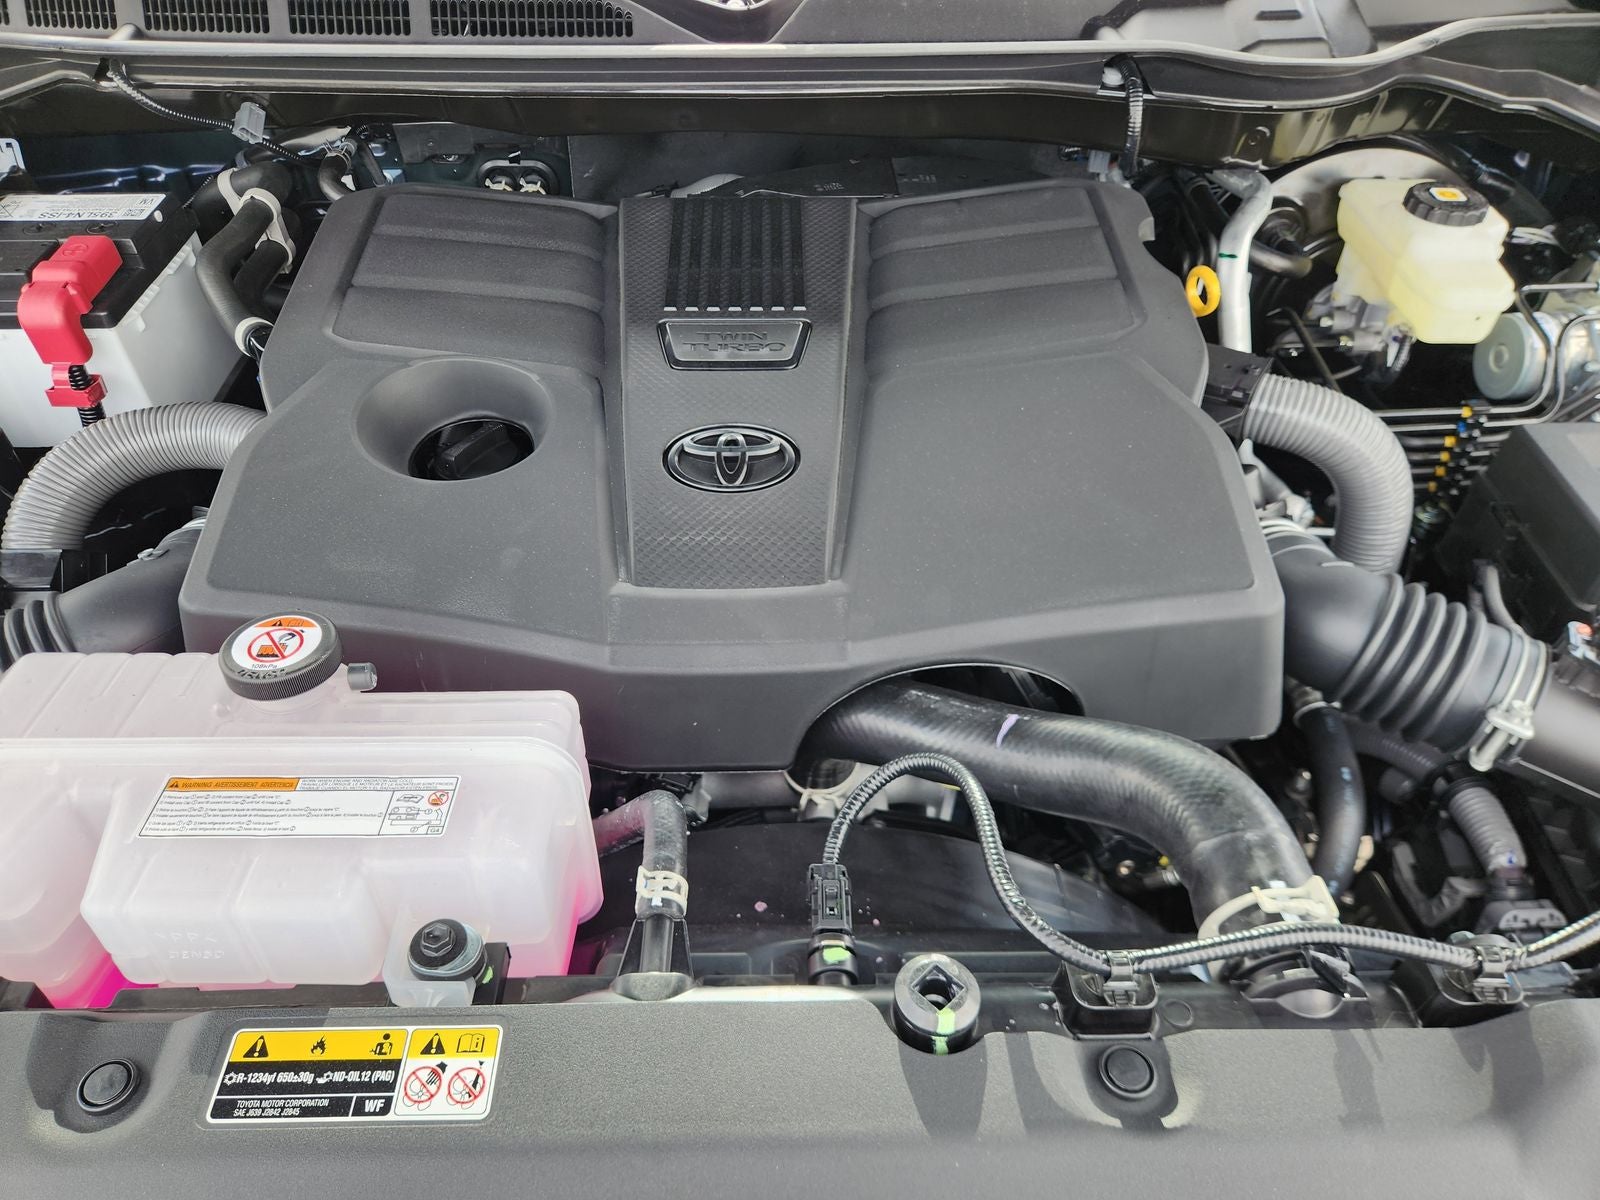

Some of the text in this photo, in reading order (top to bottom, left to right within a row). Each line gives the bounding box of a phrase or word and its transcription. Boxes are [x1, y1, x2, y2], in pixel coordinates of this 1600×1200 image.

[696, 332, 767, 340] TWIN
[682, 342, 786, 351] TURBO
[236, 1072, 275, 1085] R-1234yf
[276, 1072, 315, 1084] 650±30g
[371, 1070, 395, 1083] (PAG)
[236, 1099, 330, 1108] TOYOTA MOTOR CORPORATION
[364, 1099, 385, 1113] WF
[233, 1109, 247, 1117] SAE
[262, 1108, 281, 1116] J2842
[281, 1108, 301, 1116] J2845
